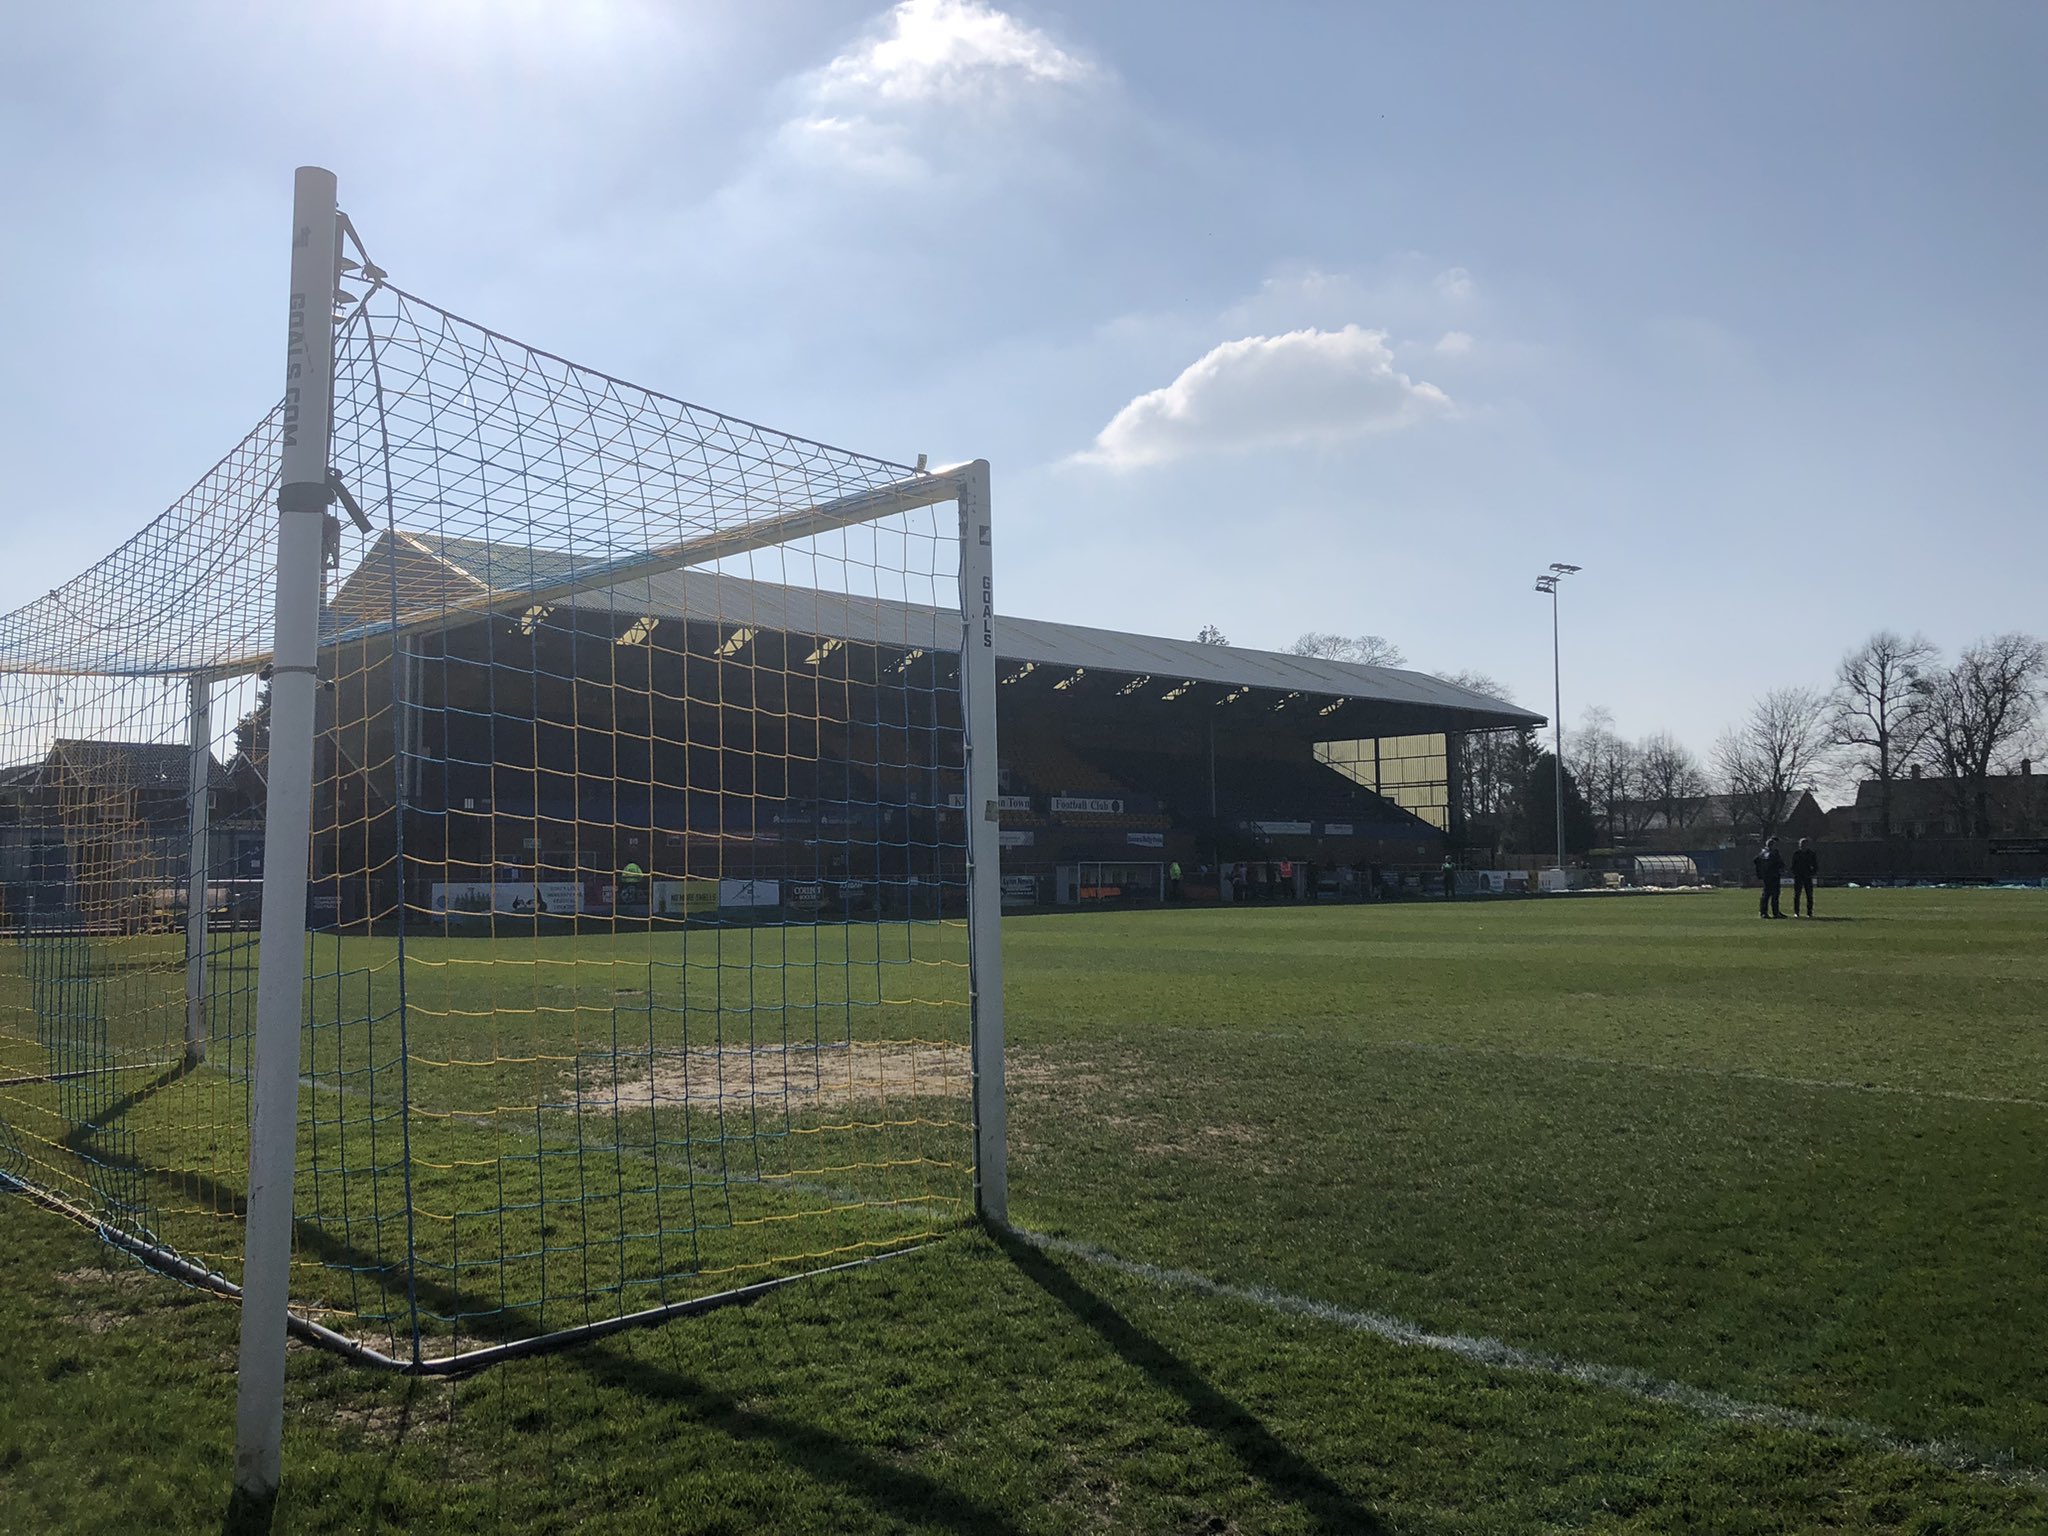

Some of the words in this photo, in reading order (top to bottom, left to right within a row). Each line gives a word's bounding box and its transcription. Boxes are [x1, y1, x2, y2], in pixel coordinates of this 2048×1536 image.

[983, 576, 992, 648] GOALS
[1008, 798, 1030, 808] Town
[1056, 799, 1087, 809] Football
[1091, 800, 1109, 810] Club
